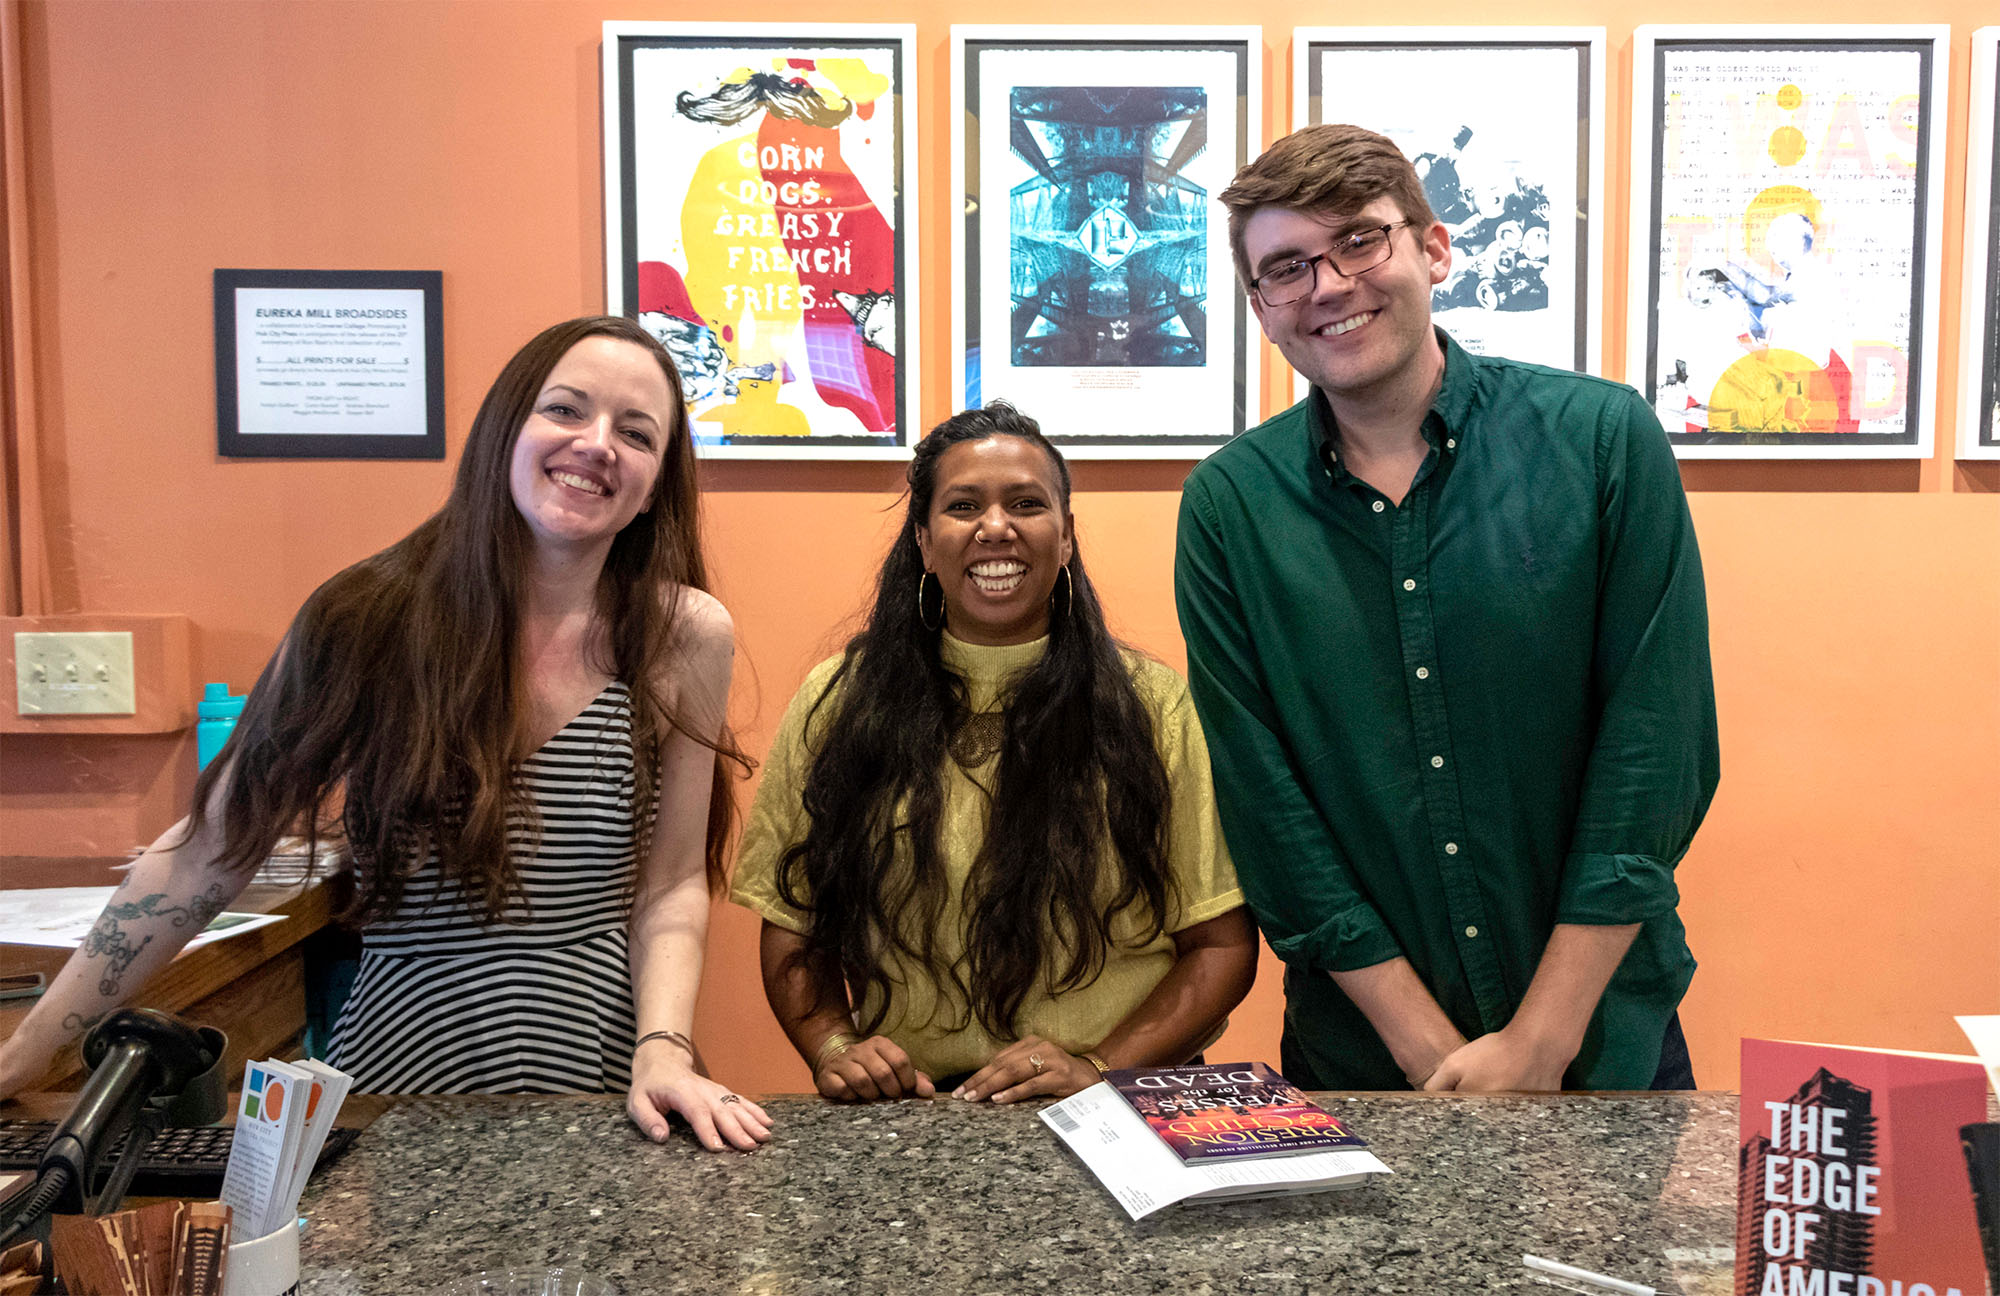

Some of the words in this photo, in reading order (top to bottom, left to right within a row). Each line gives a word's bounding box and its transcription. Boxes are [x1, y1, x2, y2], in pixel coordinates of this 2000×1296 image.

[738, 142, 824, 171] CORN
[740, 180, 832, 206] DOGS.
[713, 212, 844, 240] GREASY
[727, 244, 851, 276] FRENCH
[722, 283, 838, 312] FRIES...
[255, 308, 303, 319] EUREKA
[306, 308, 333, 319] MILL
[335, 308, 408, 319] BROADSIDES
[304, 357, 334, 365] PRINTS
[336, 357, 354, 365] FOR
[356, 357, 376, 365] SALE
[1135, 1070, 1264, 1089] DEAD
[1217, 1084, 1240, 1096] for
[1158, 1093, 1296, 1112] VERSES
[1180, 1088, 1209, 1098] the
[1168, 1114, 1293, 1134] CHILD
[1299, 1112, 1329, 1125] &
[1764, 1101, 1848, 1157] THE
[1177, 1124, 1352, 1147] PRESTON
[1764, 1154, 1882, 1216] EDGE
[1762, 1208, 1821, 1260] OF
